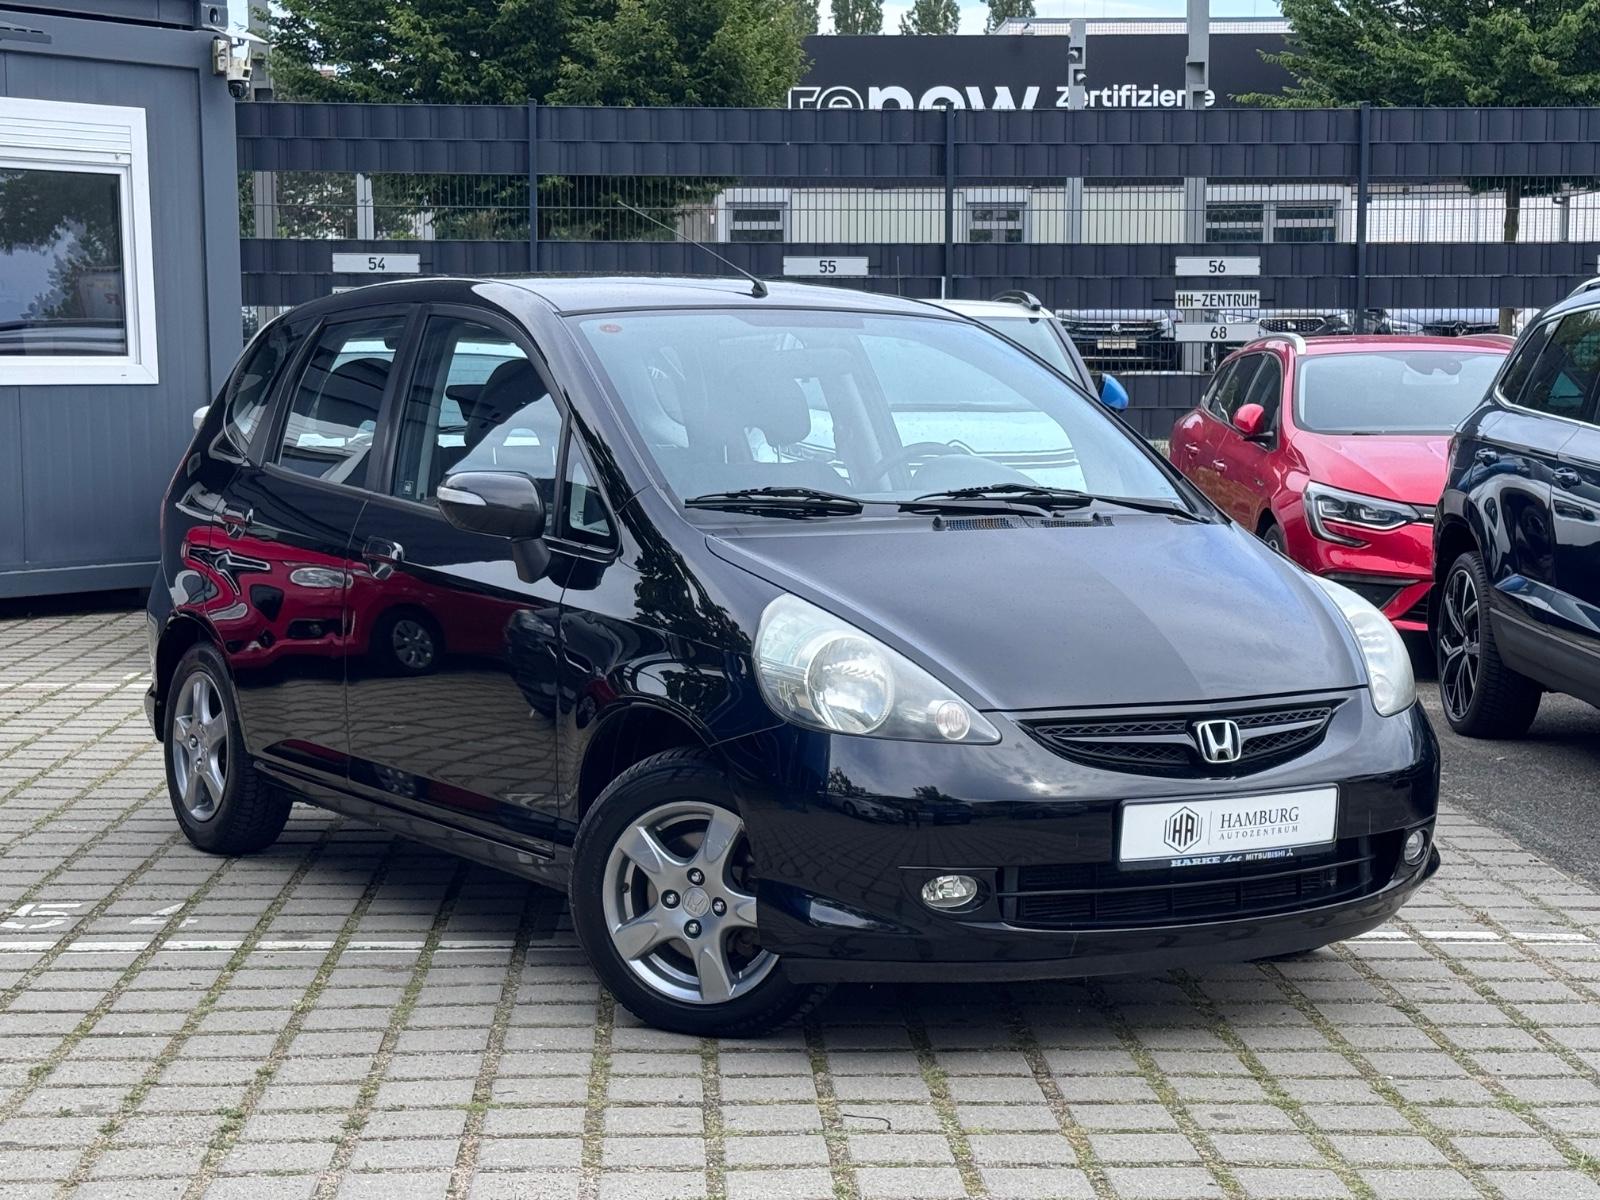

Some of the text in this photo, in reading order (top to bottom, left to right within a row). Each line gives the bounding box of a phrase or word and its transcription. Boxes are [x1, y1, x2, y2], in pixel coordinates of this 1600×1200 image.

[1056, 84, 1215, 107] Zrtifiziere
[368, 257, 385, 271] 54
[819, 260, 837, 273] 55
[1209, 260, 1226, 273] 56
[1177, 293, 1257, 307] HH-ZENTRUM
[1210, 326, 1227, 339] 68
[1220, 806, 1299, 829] HAMBURG
[1219, 825, 1298, 840] AUTOZENTRUM
[1171, 856, 1220, 867] HARKE
[1245, 850, 1286, 861] MITSUBISHI
